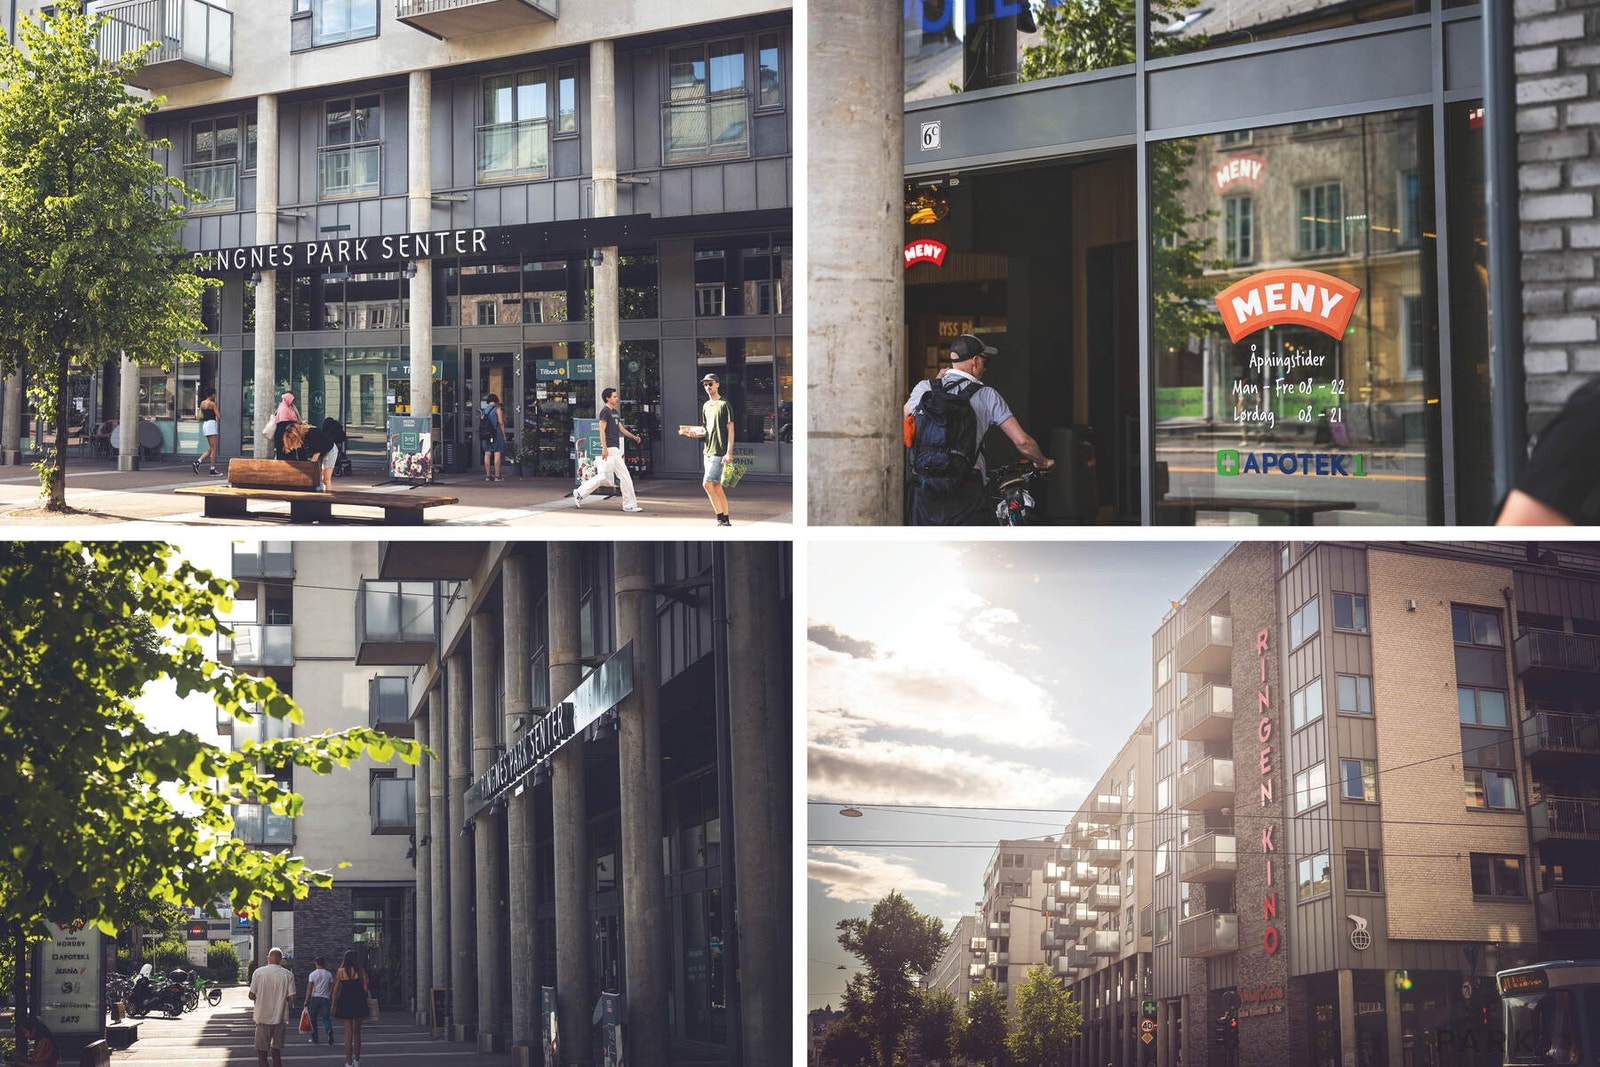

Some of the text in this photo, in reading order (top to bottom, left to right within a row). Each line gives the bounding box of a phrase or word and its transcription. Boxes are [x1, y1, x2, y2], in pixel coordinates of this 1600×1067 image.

[1216, 158, 1262, 188] MENY
[194, 229, 487, 272] RINGNES PARK SENTER
[904, 243, 942, 262] MENY
[1231, 282, 1344, 324] MENY
[1249, 344, 1326, 374] Åpningstider
[1232, 379, 1258, 396] Man
[1275, 378, 1295, 398] Fre
[1299, 378, 1313, 396] 08
[1330, 378, 1345, 396] 22
[1233, 406, 1275, 429] Lørdag
[1298, 406, 1313, 423] 08
[1330, 407, 1342, 424] 21
[1243, 452, 1348, 476] APOTEK
[1352, 453, 1367, 477] 1
[529, 702, 564, 761] SENTER
[1256, 628, 1280, 956] RINGEN KINO
[60, 1015, 80, 1023] SATS
[1142, 1021, 1153, 1030] 40
